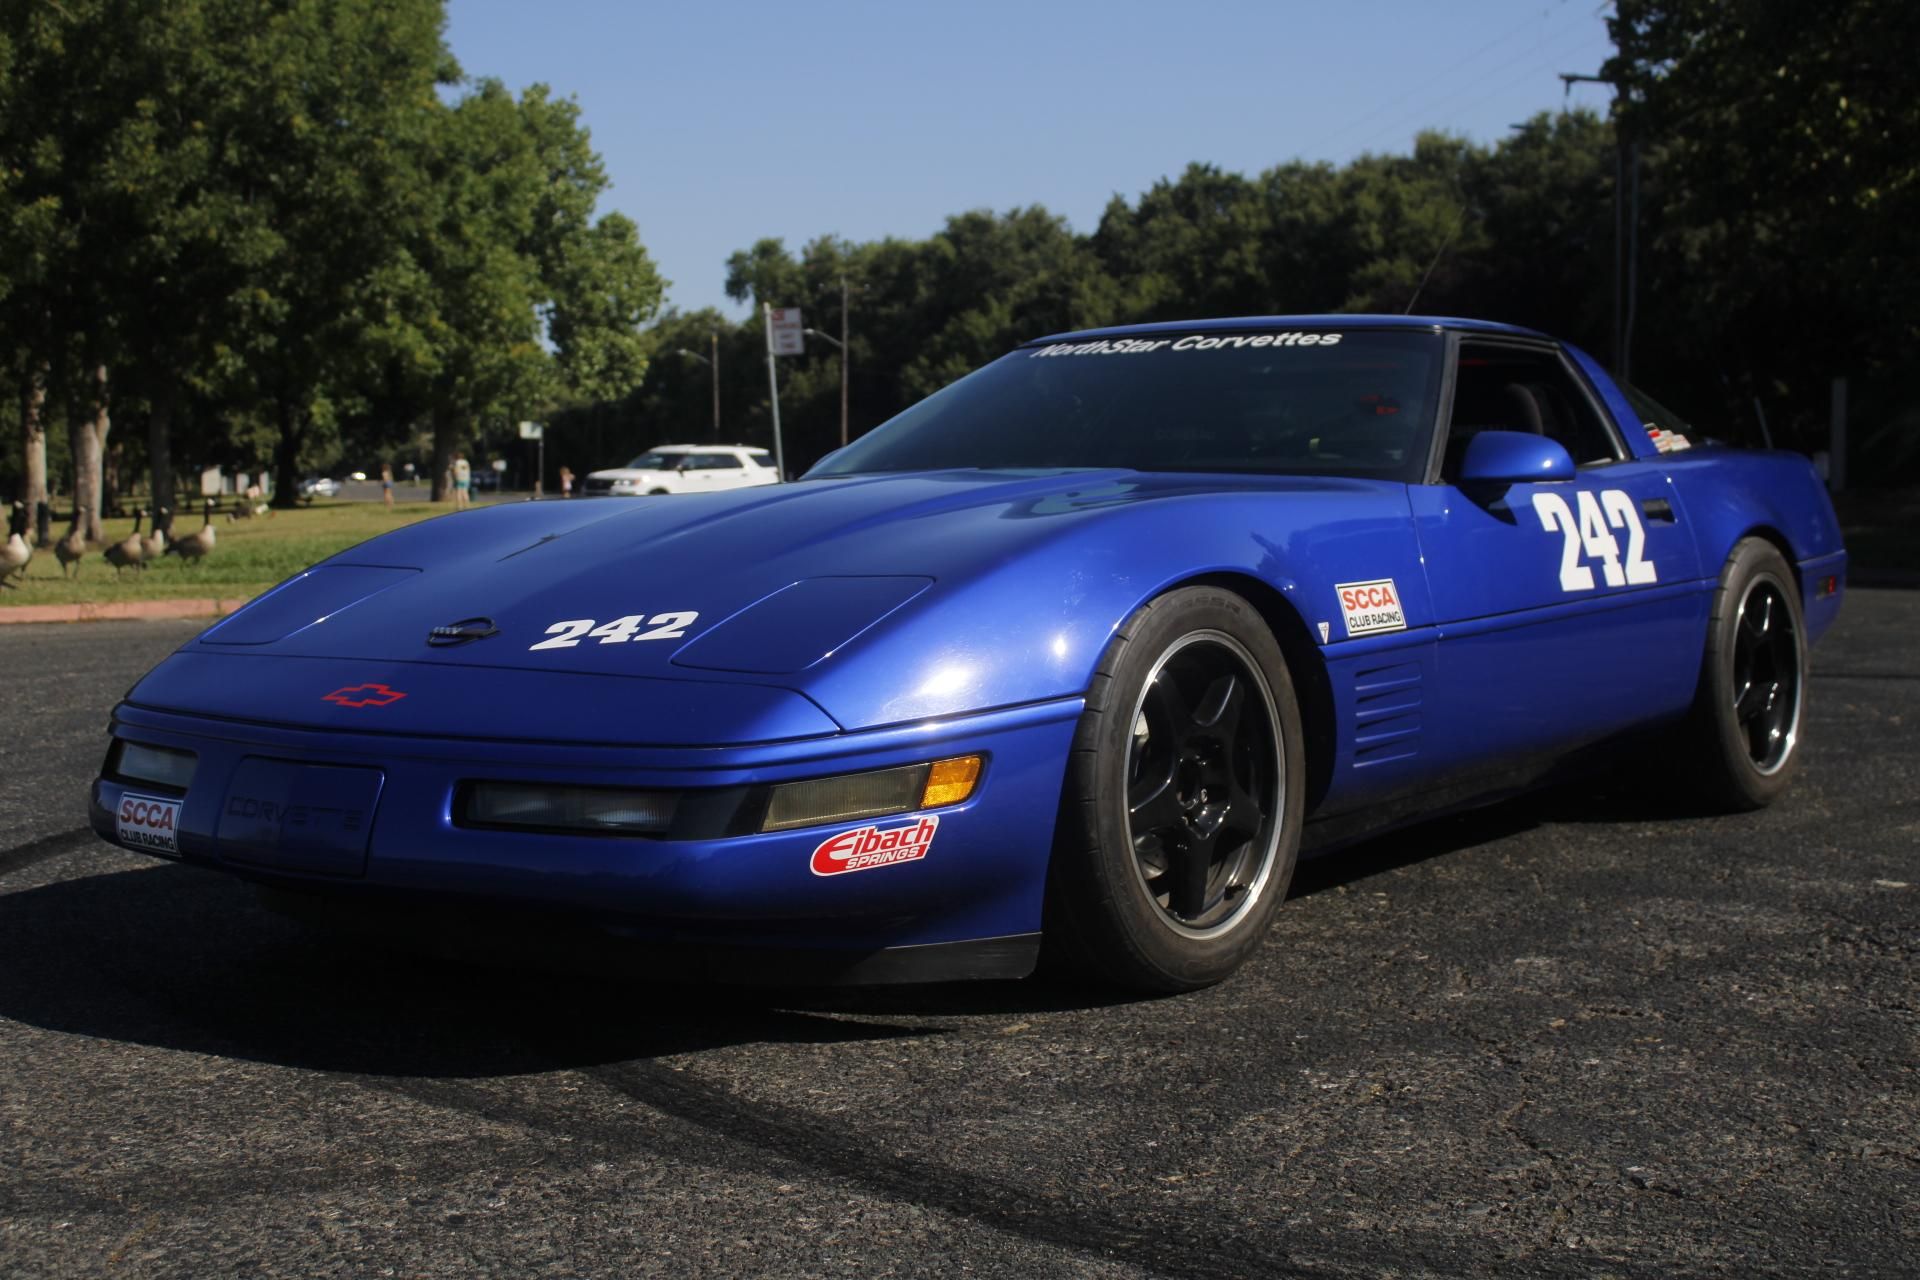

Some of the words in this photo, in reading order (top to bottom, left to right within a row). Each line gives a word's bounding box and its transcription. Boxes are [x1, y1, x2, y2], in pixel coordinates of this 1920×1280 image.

[1171, 332, 1342, 351] Corvettes
[1532, 490, 1657, 592] 242
[1342, 586, 1395, 611] SCCA
[528, 610, 700, 651] 242
[1349, 614, 1371, 629] CLUB
[1371, 610, 1402, 626] RACING
[120, 799, 174, 831] SCCA
[120, 829, 142, 845] CLUB
[141, 831, 175, 850] RACING
[812, 818, 936, 870] Eibach
[845, 845, 921, 870] SPRINGS
